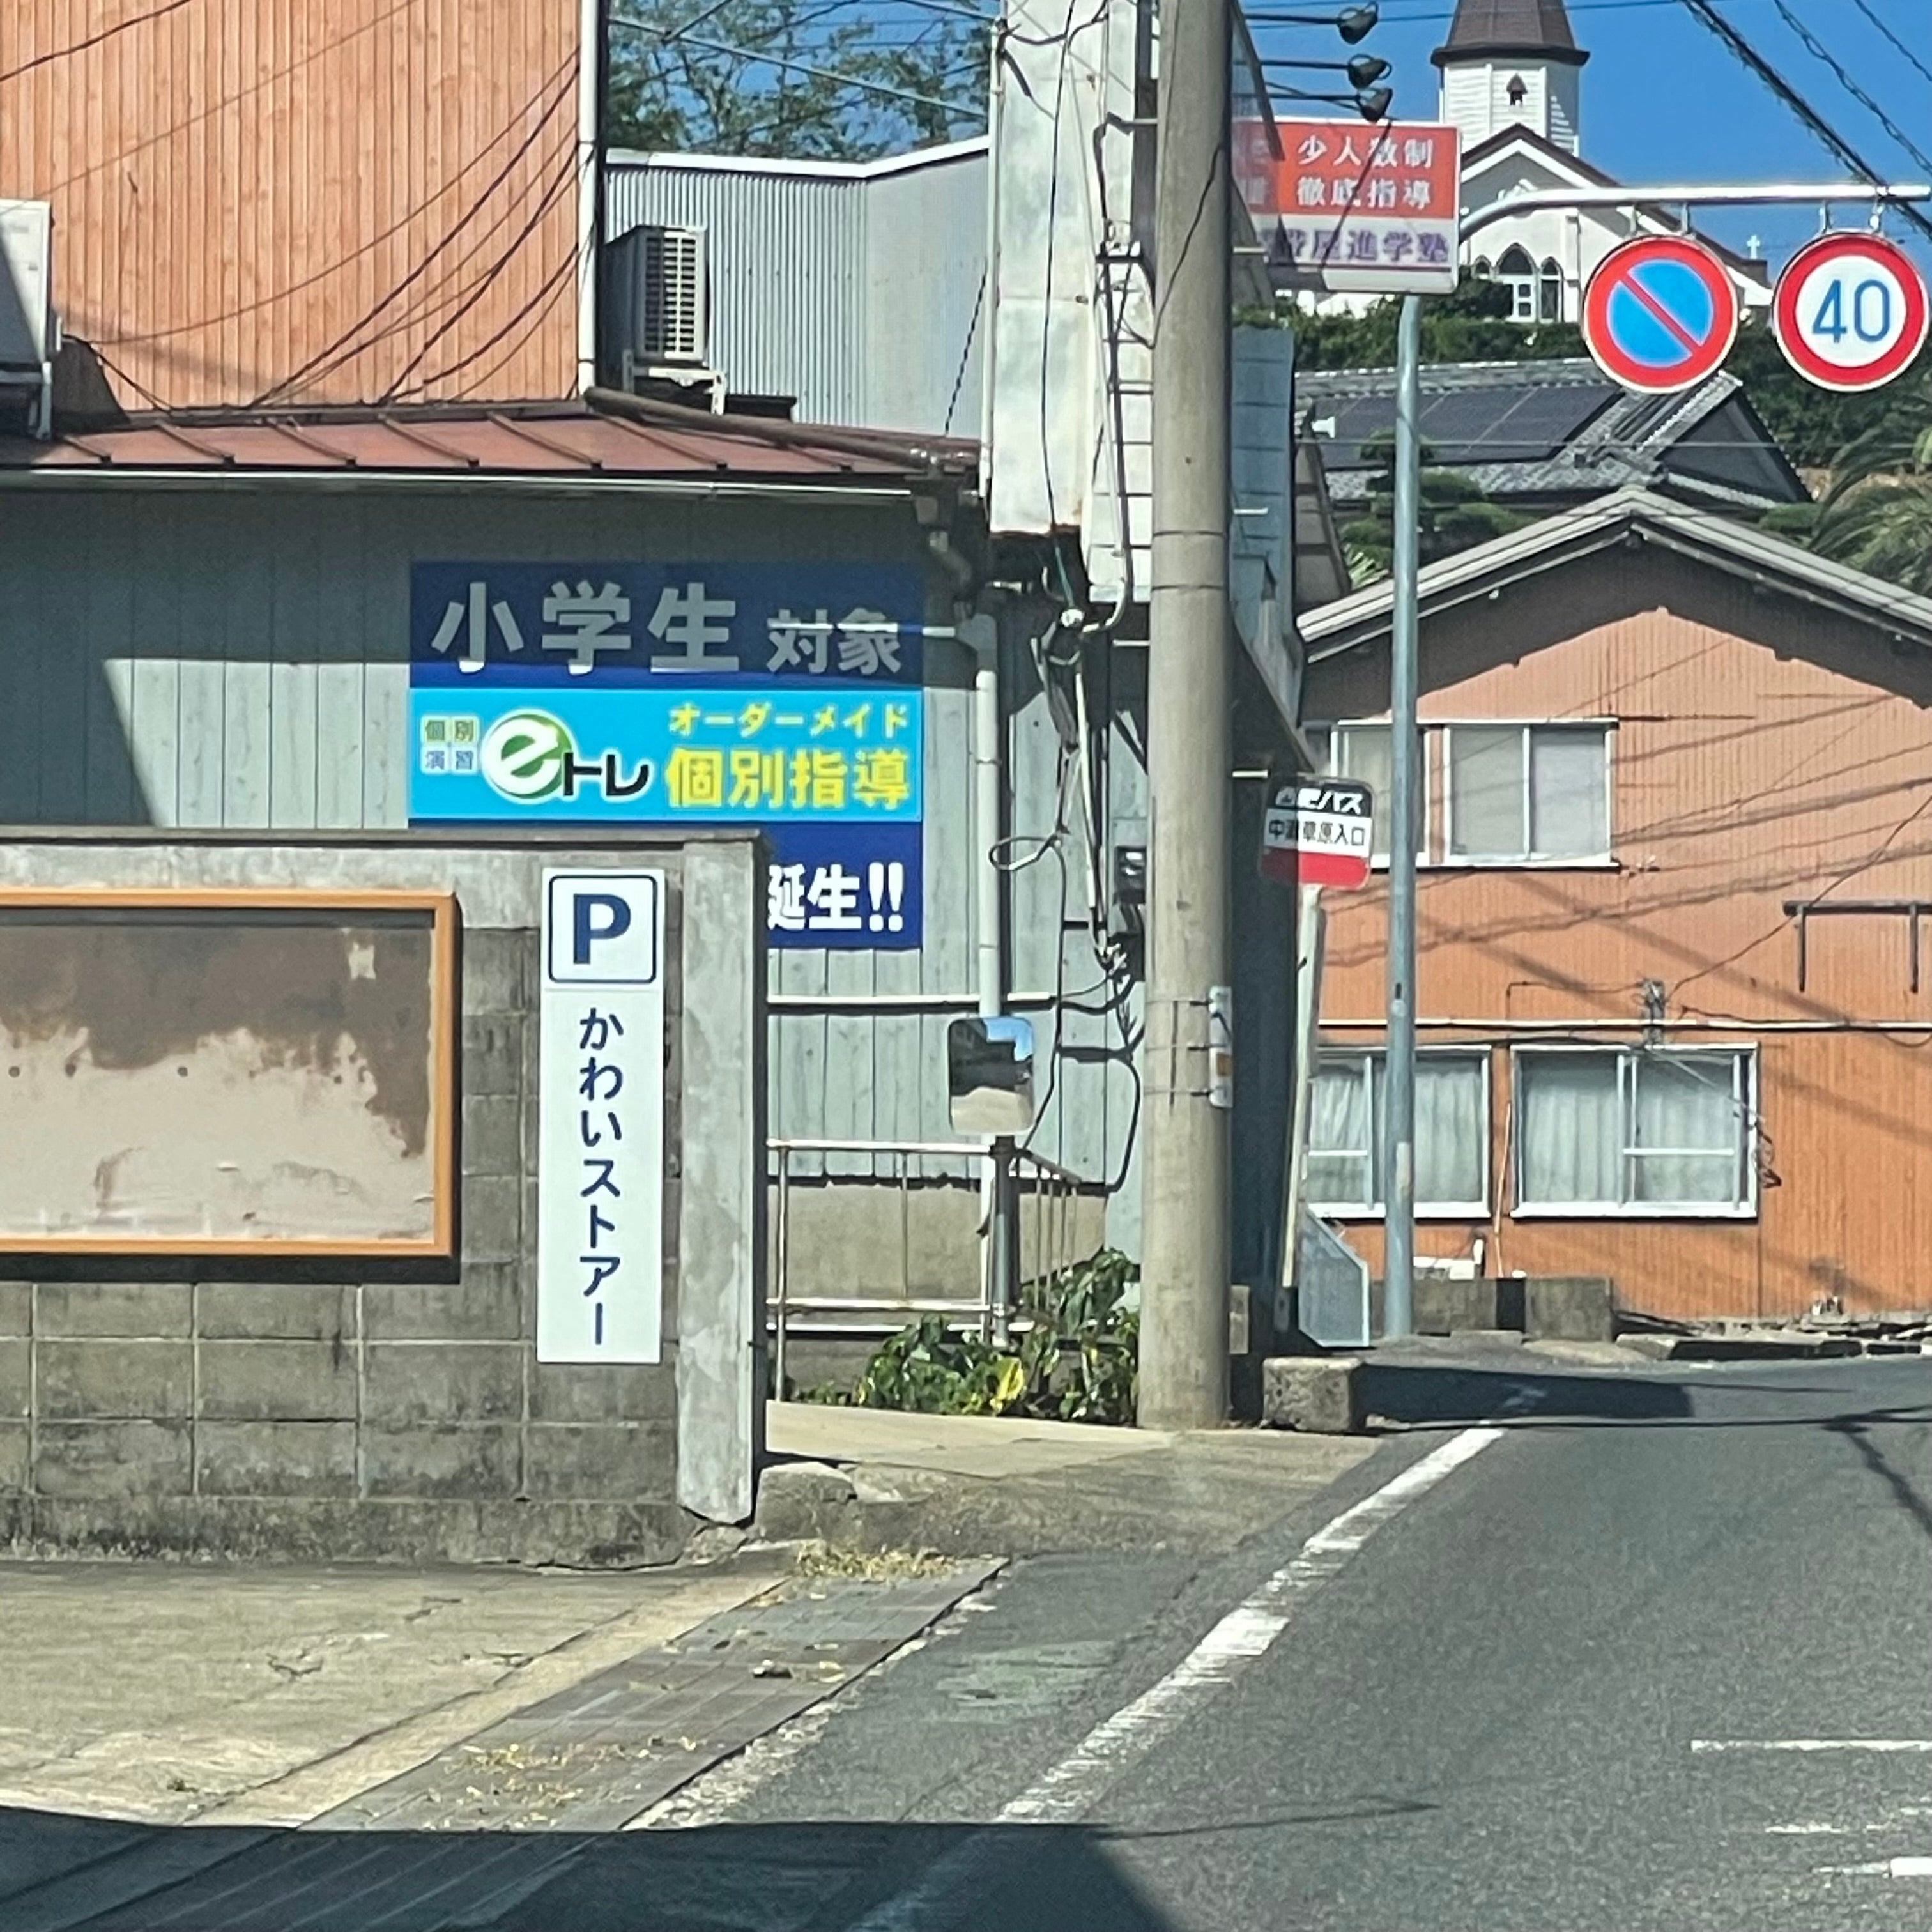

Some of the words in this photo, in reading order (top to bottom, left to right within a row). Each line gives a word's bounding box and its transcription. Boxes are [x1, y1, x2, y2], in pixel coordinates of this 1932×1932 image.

[1298, 135, 1433, 169] 少人数制
[1297, 176, 1431, 210] 徹底指導
[1813, 279, 1890, 344] 40
[431, 581, 739, 674] 小学生
[767, 608, 901, 674] 対象
[425, 719, 475, 742] 個別
[669, 702, 908, 738] オーダーメイド
[666, 747, 910, 809] 個別指導
[572, 893, 632, 965] P
[579, 1007, 624, 1345] かわいストアー
